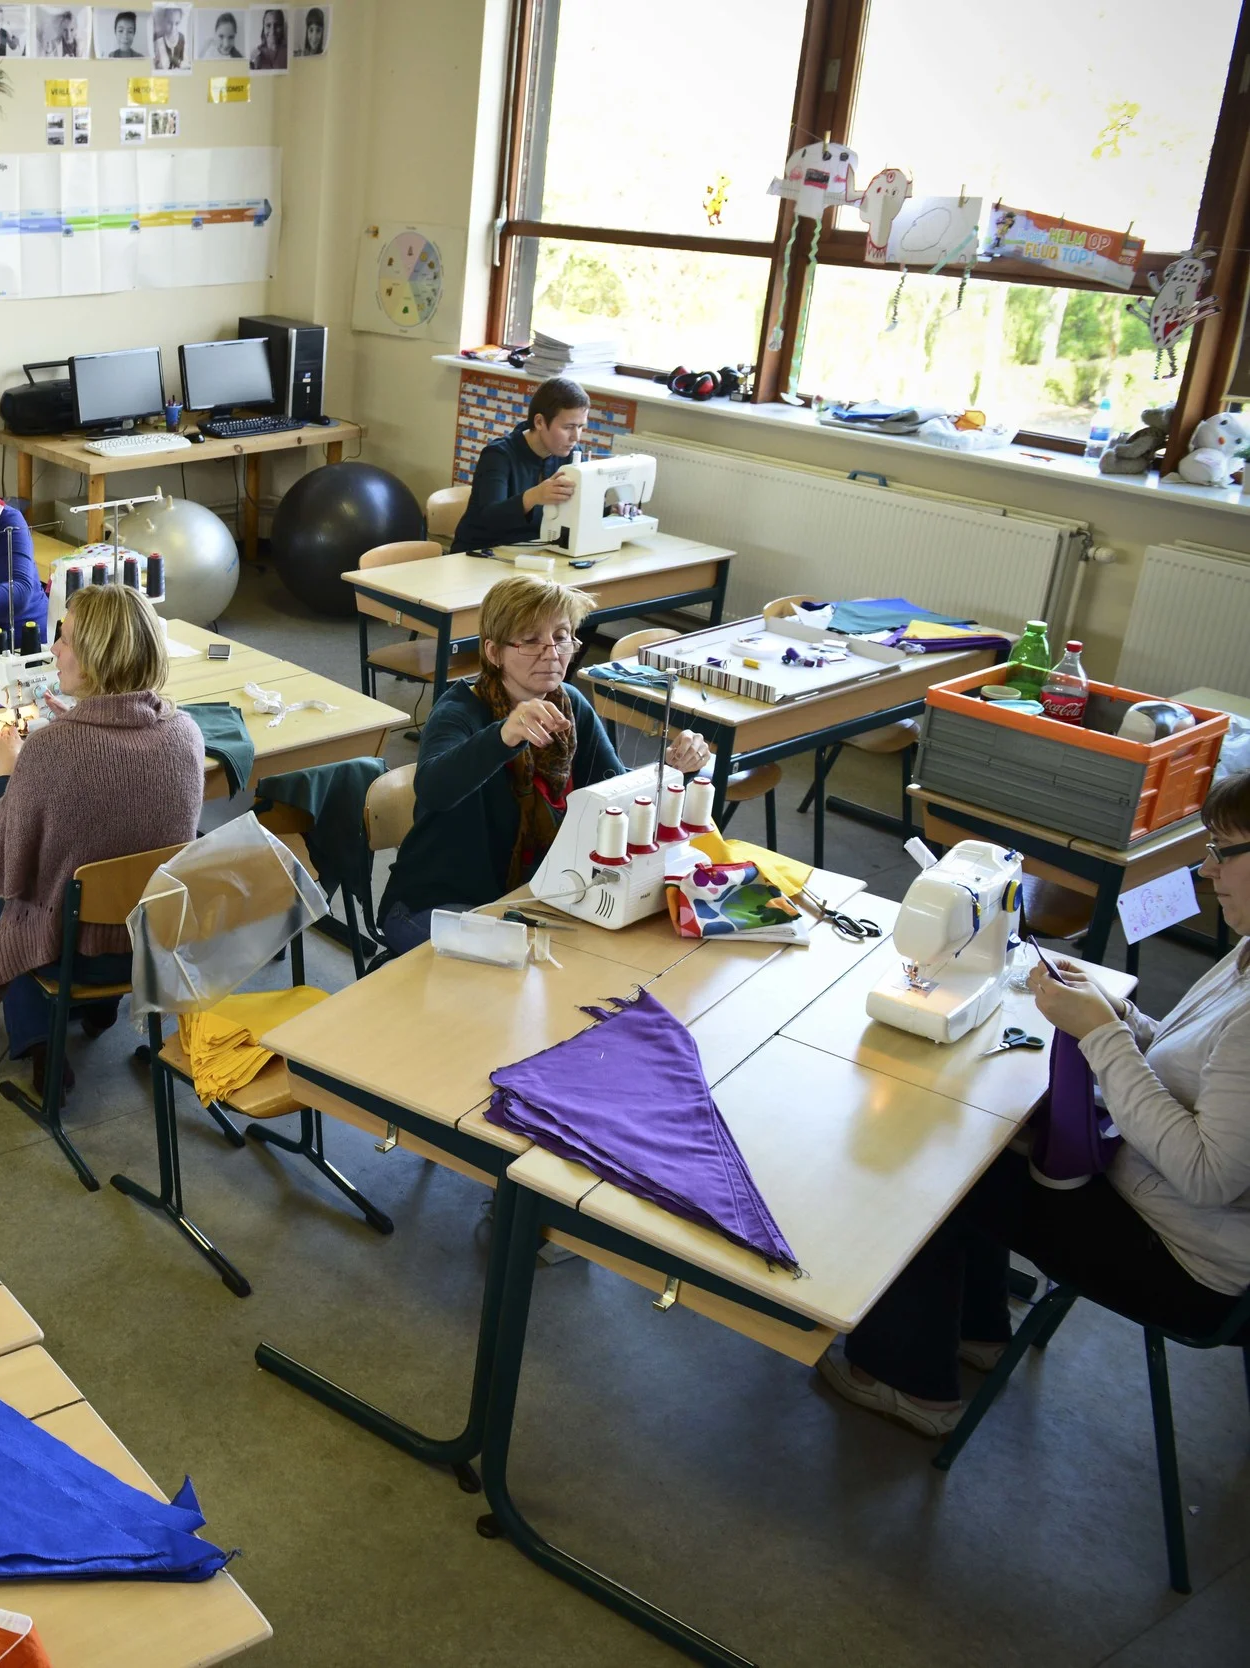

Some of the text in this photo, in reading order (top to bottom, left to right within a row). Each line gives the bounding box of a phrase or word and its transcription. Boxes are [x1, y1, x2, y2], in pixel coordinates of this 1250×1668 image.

[1048, 228, 1088, 246] HELM
[1089, 232, 1112, 251] OP
[1023, 242, 1059, 260] FLUO
